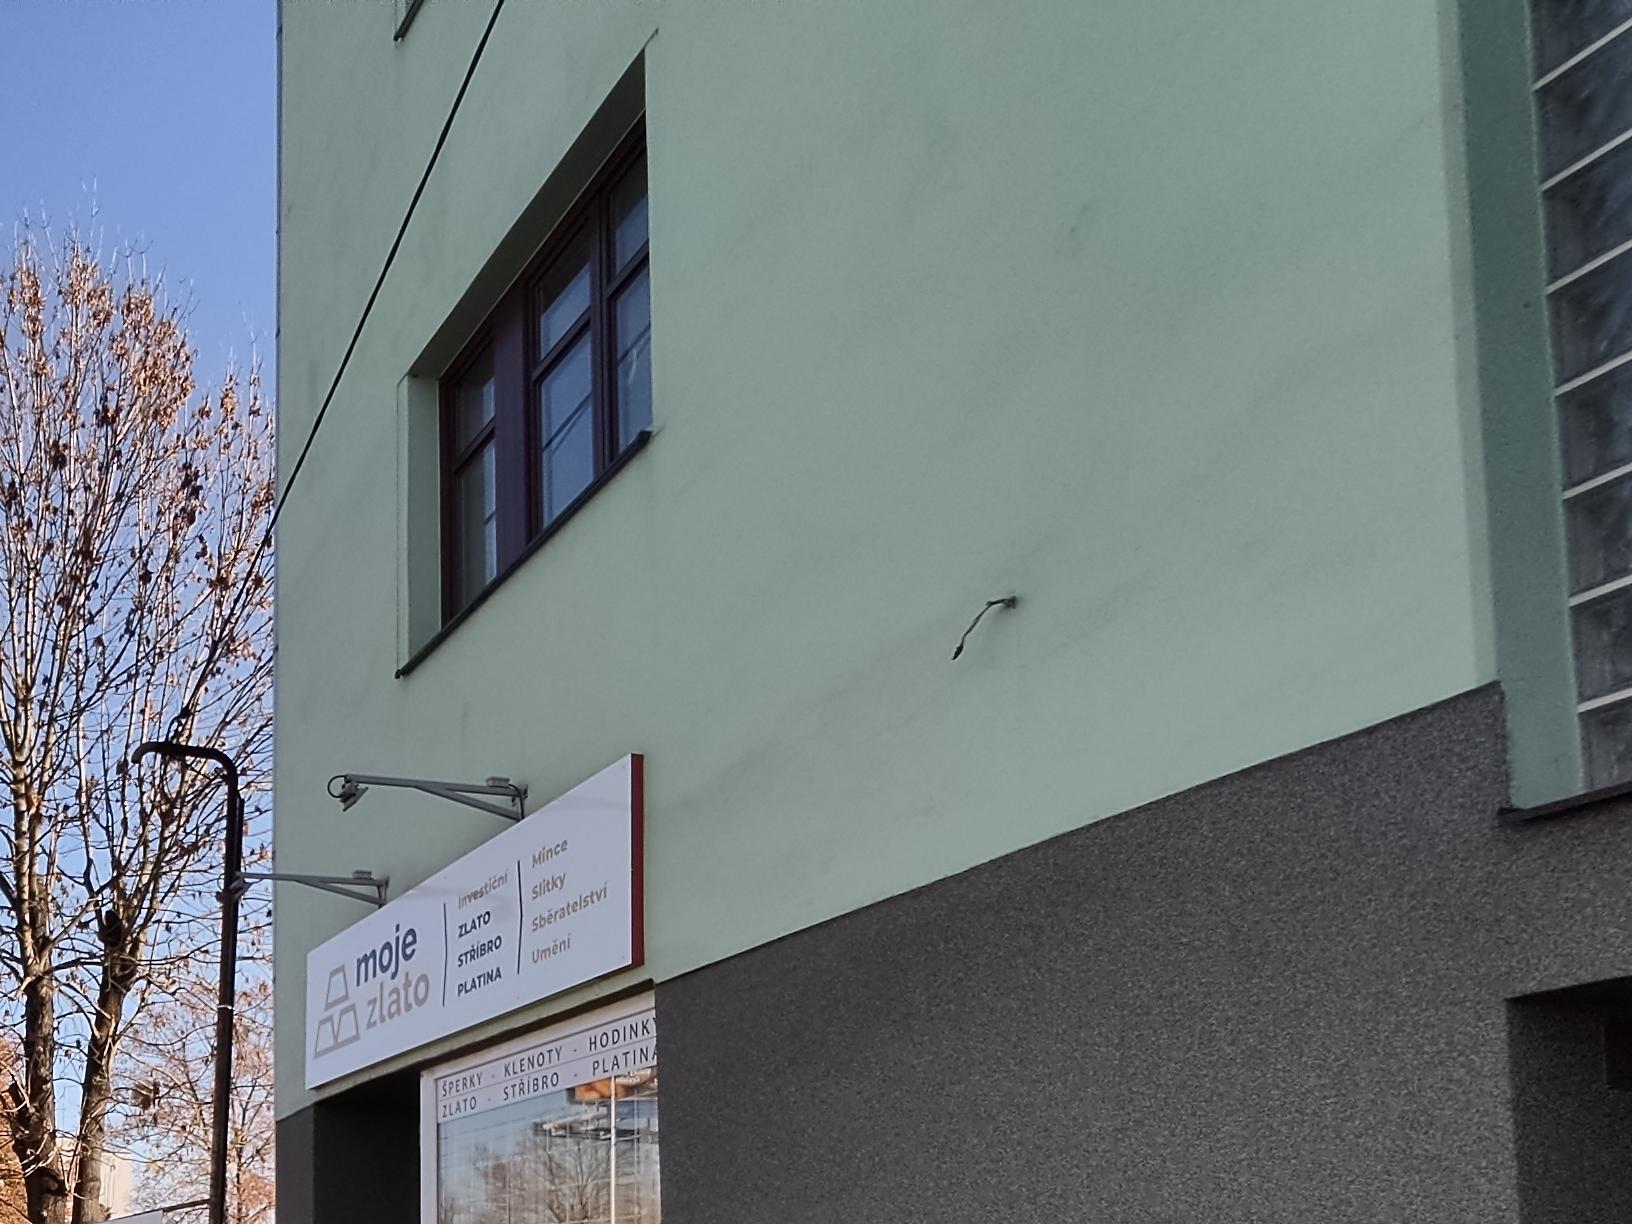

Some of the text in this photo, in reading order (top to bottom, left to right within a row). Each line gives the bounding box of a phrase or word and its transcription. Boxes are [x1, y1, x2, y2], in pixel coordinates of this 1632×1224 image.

[531, 837, 569, 869] Mince
[457, 872, 509, 909] Investiční
[531, 882, 608, 933] Sběratelství
[457, 911, 492, 939] ZLATO
[355, 924, 417, 988] moje
[457, 935, 503, 969] STŘÍBRO
[531, 934, 572, 965] Umění
[457, 967, 502, 998] PLATINA
[366, 972, 430, 1031] zlato
[441, 1071, 483, 1098] ŠPERKY
[504, 1045, 563, 1078] KLENOTY
[441, 1096, 478, 1118] ZLATO
[503, 1071, 560, 1101] STŘÍBRO
